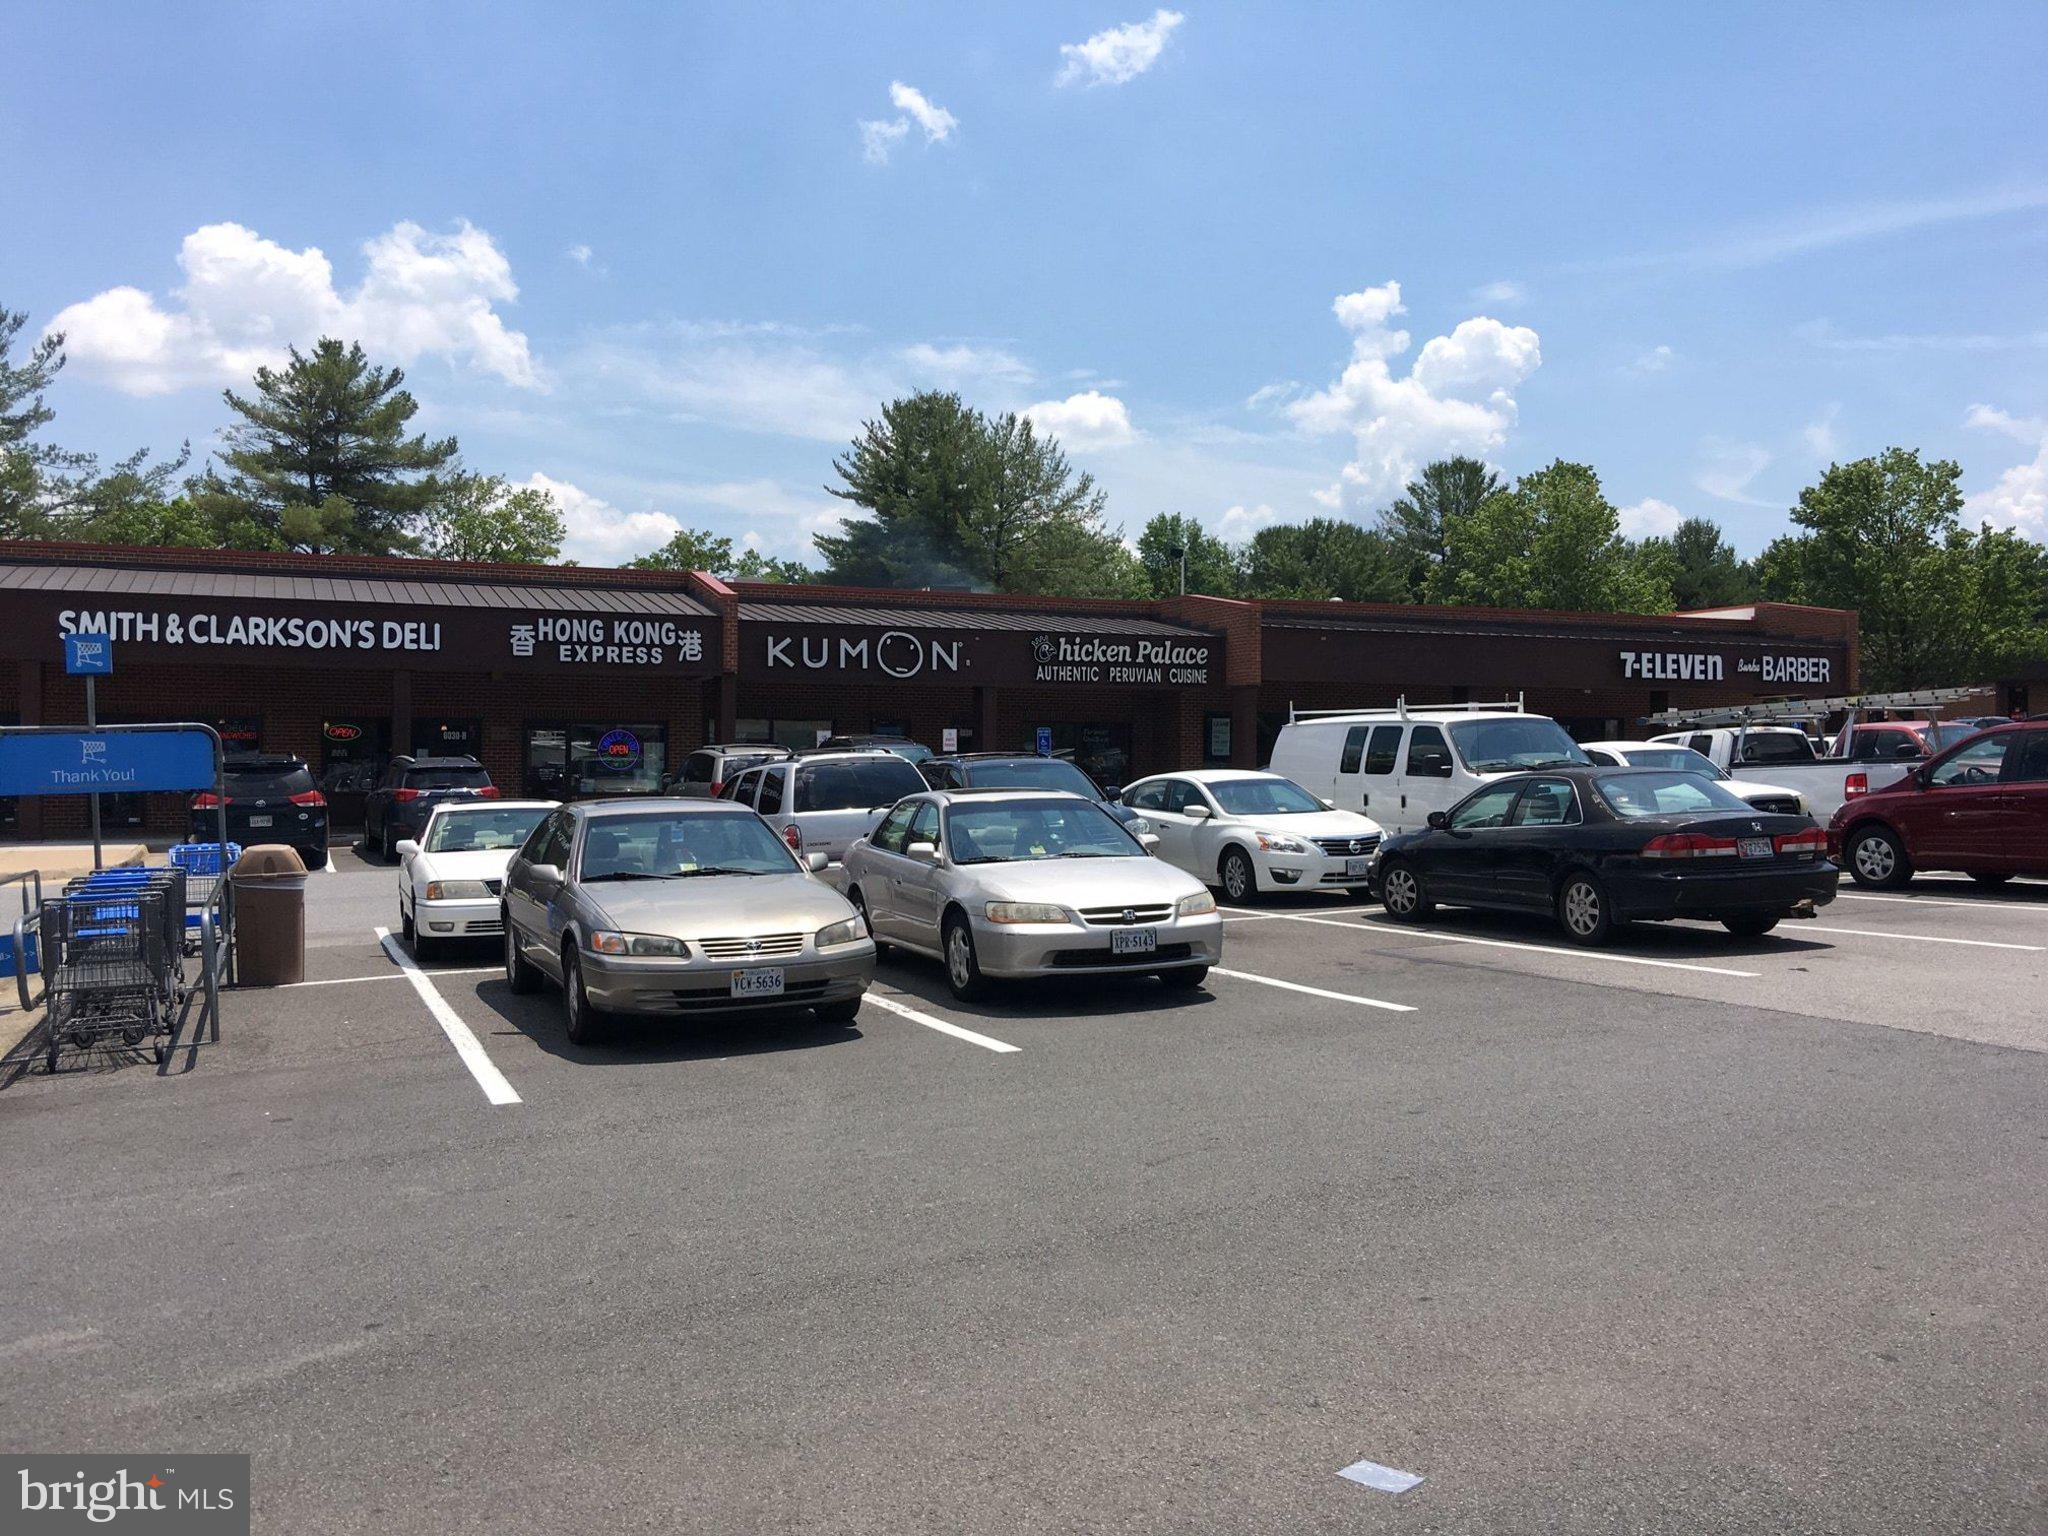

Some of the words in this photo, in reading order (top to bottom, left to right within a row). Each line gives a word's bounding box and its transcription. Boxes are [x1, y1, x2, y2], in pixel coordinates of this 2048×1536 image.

[59, 610, 159, 642] SMITH
[165, 613, 184, 644] &
[188, 614, 375, 649] CLARKSON'S
[382, 621, 441, 651] DELI
[510, 624, 536, 656] 香
[538, 618, 604, 643] HONG
[614, 621, 676, 645] KONG
[559, 645, 663, 664] EXPRESS
[677, 630, 702, 662] 港
[767, 631, 958, 678] KUMON
[1136, 640, 1208, 665] Palace
[1036, 666, 1100, 681] AUTHENTIC
[1109, 667, 1161, 683] PERUVIAN
[1169, 668, 1208, 684] CUISINE
[1762, 655, 1830, 683] BARBER
[329, 727, 357, 738] OPEN
[609, 744, 629, 756] OPEN
[51, 769, 99, 783] Thank
[102, 768, 135, 781] You!
